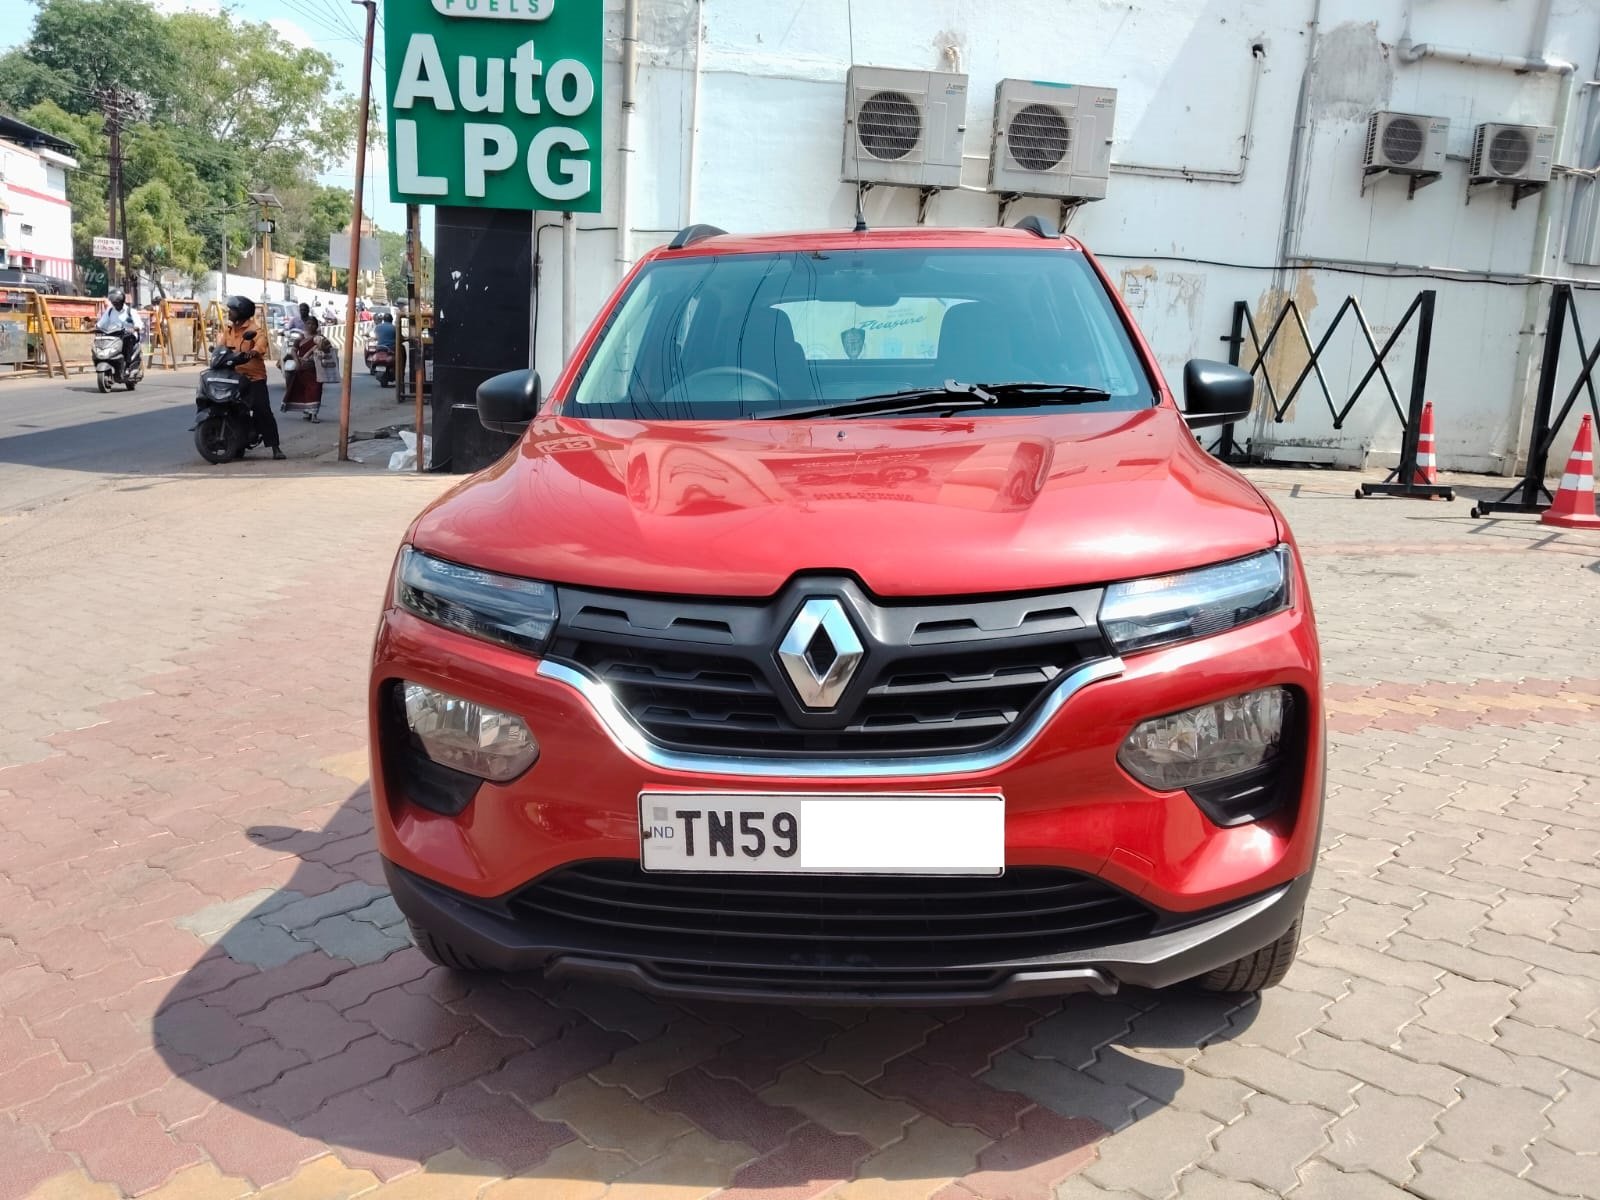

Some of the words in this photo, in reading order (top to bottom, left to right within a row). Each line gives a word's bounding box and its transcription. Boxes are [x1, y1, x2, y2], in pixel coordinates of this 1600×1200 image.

[393, 33, 594, 116] Auto
[395, 119, 591, 200] LPG
[860, 315, 927, 330] Pleasure
[650, 826, 674, 839] IND
[675, 810, 798, 858] TN59
